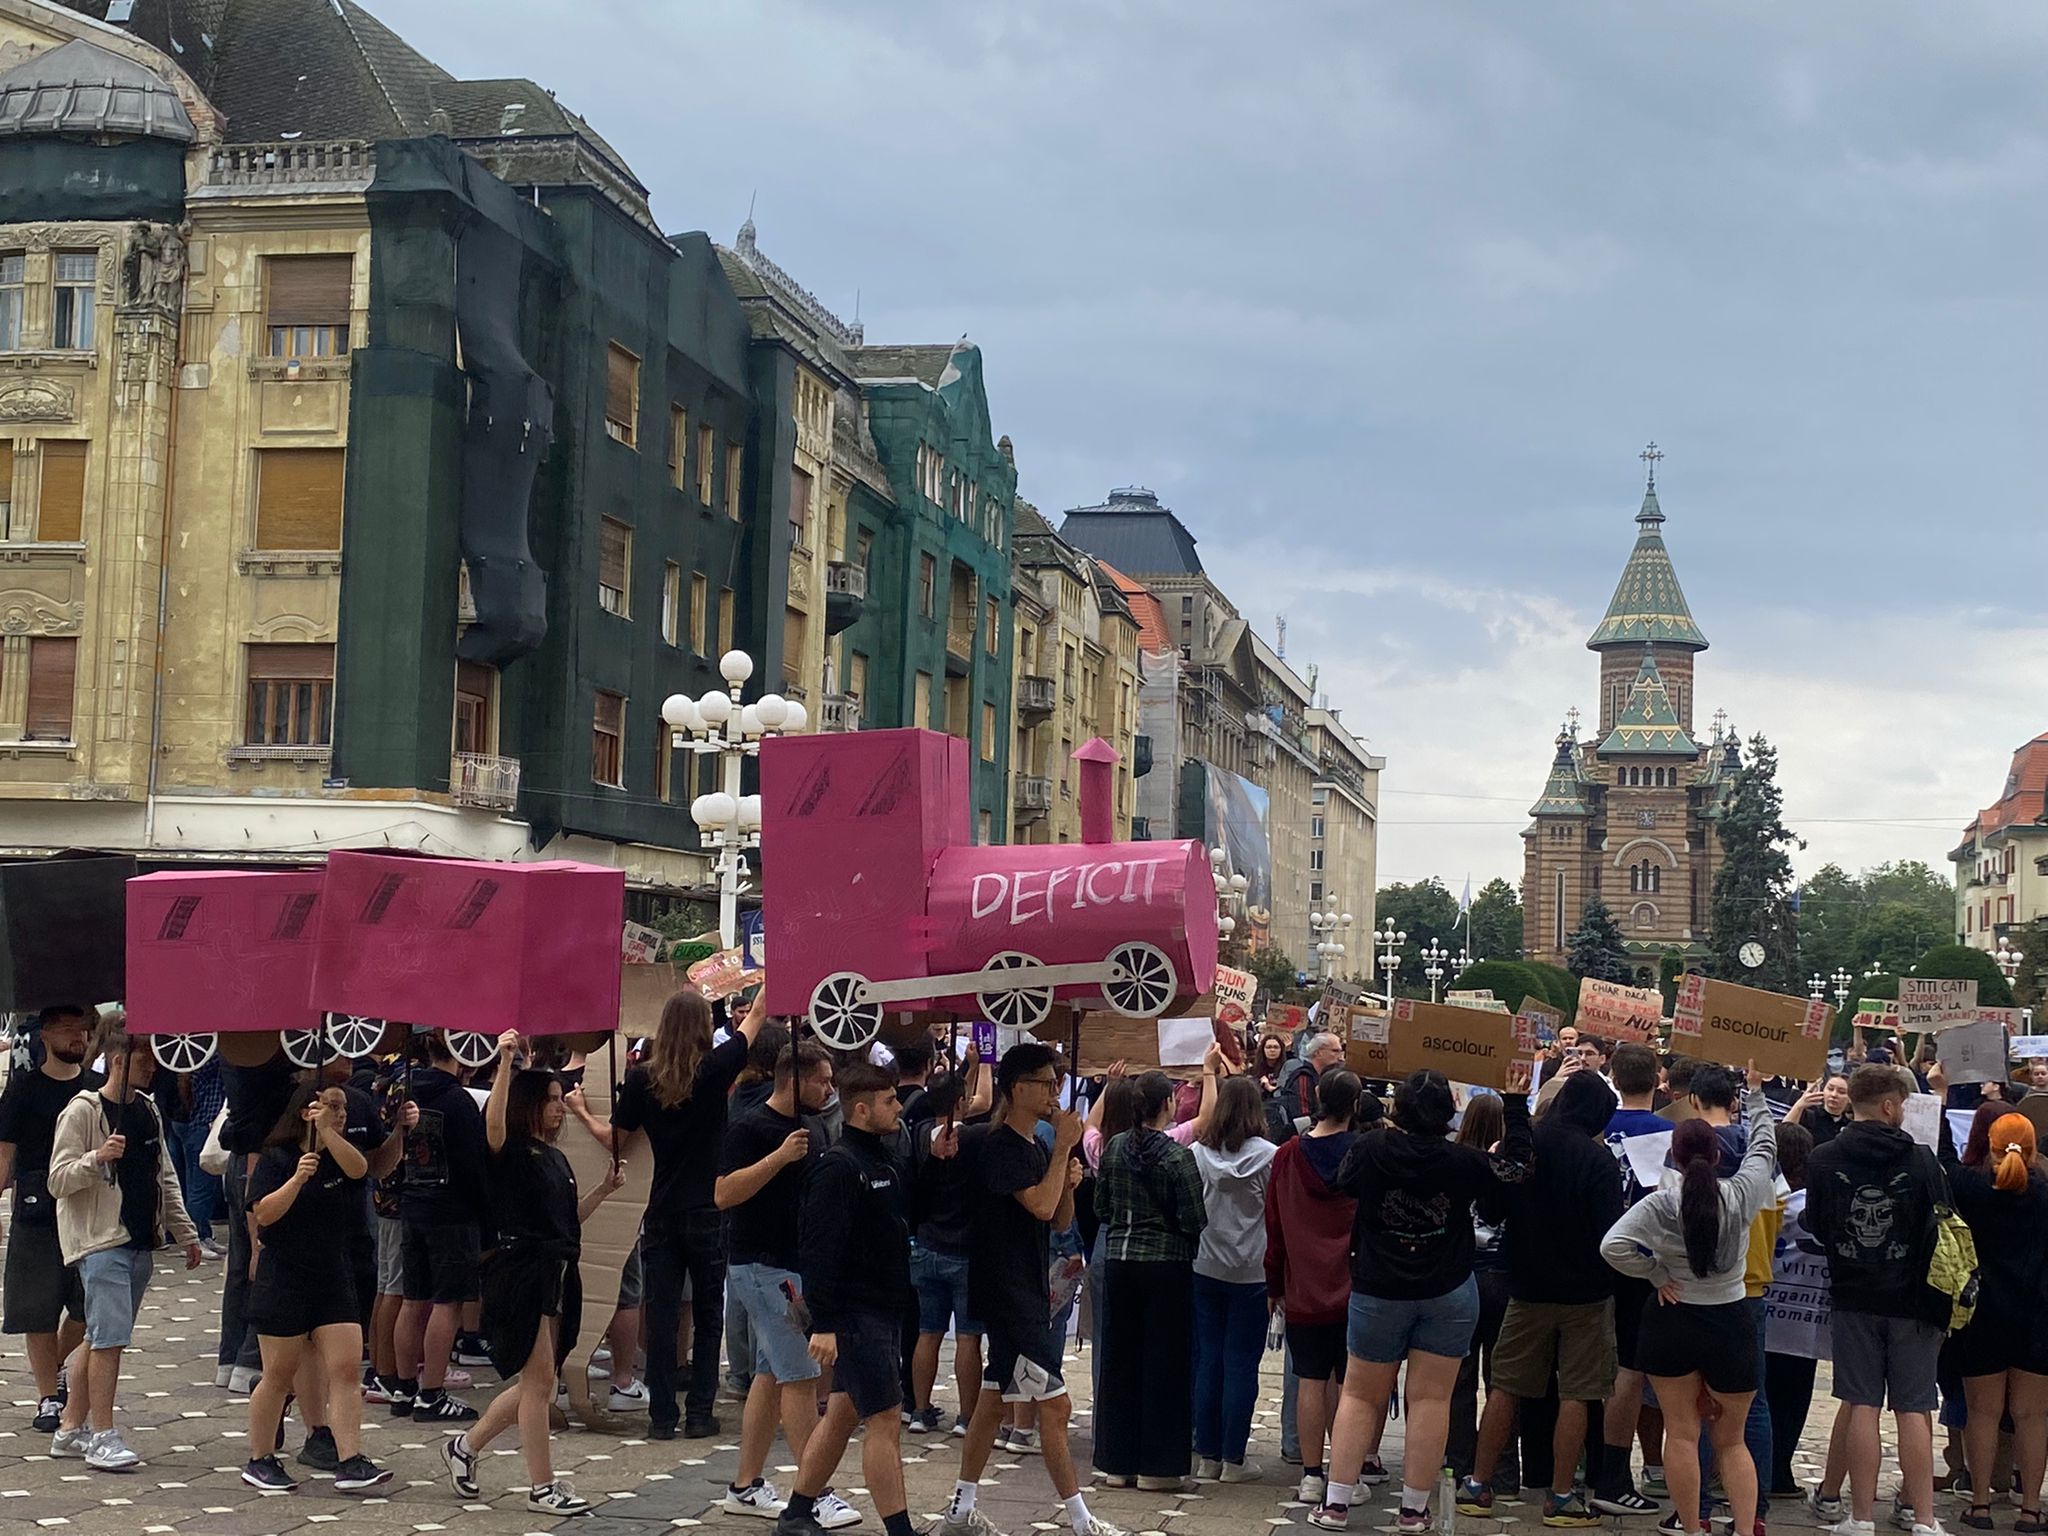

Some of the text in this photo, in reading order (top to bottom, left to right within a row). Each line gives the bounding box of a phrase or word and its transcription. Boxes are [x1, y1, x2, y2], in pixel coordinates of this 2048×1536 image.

[972, 858, 1168, 925] DEFICIT
[1216, 984, 1247, 1002] PUNS
[1949, 1002, 1962, 1010] LA
[1625, 1014, 1653, 1031] NU
[1766, 1305, 1831, 1325] Români
